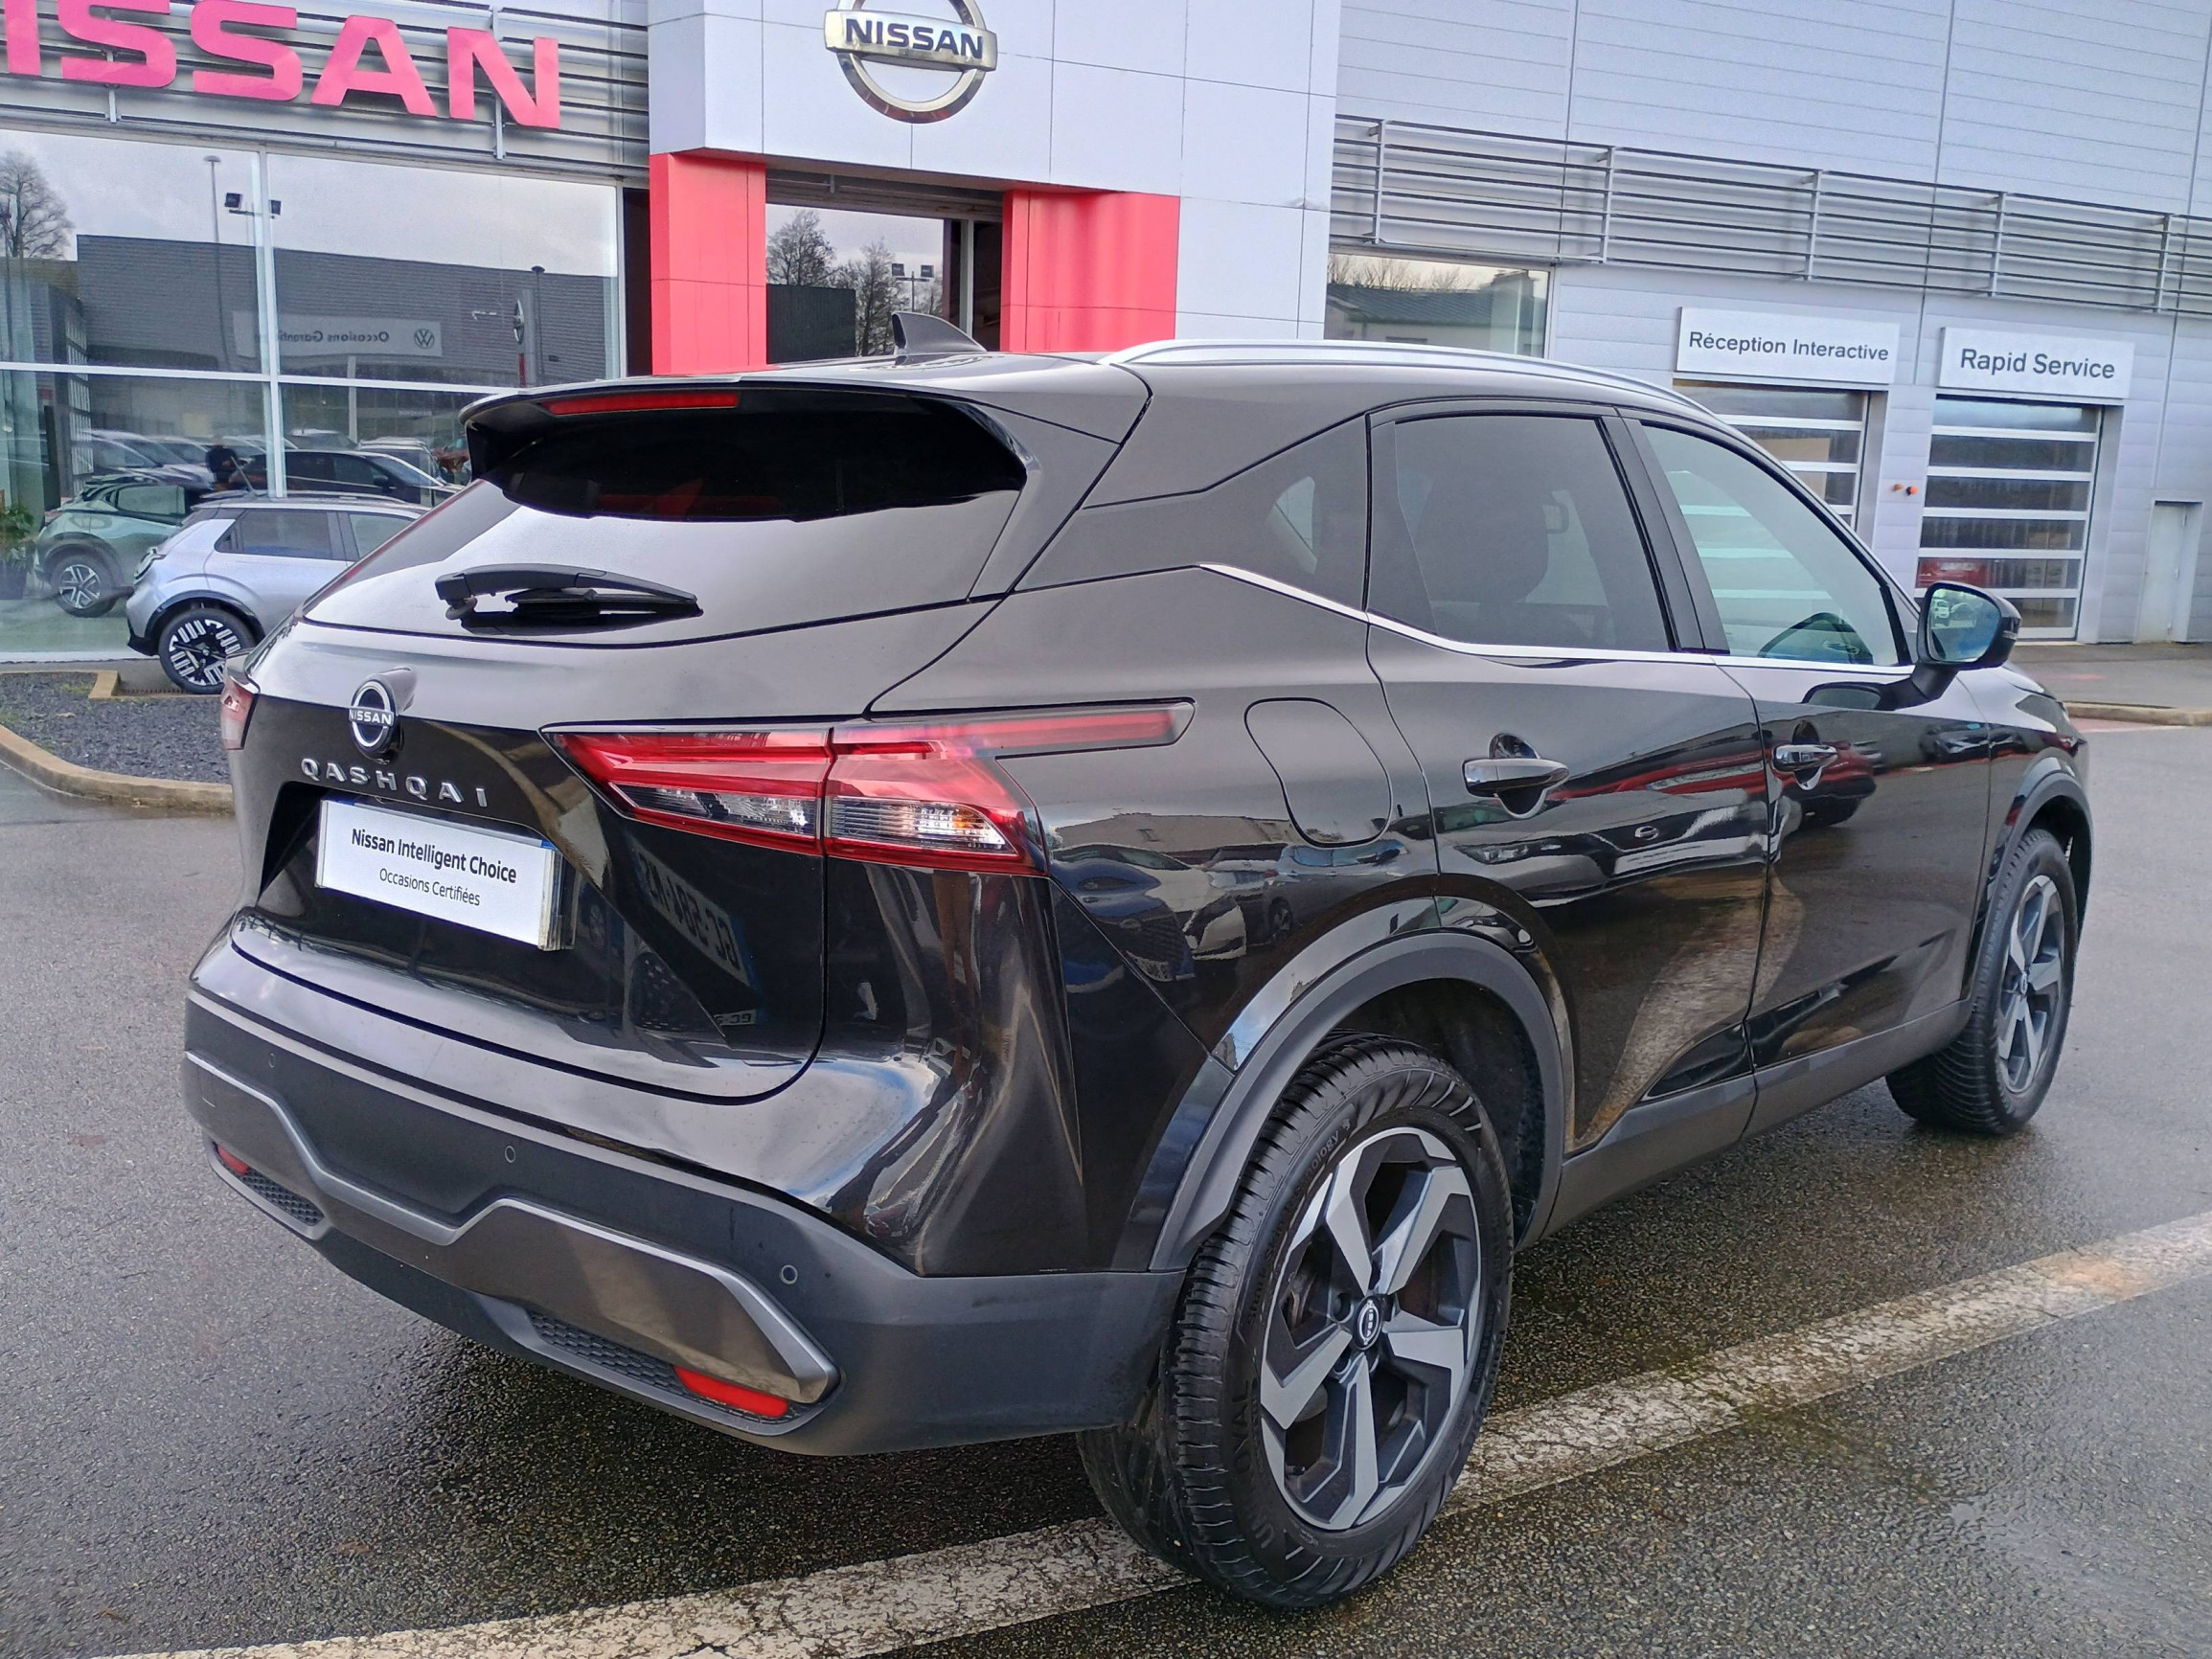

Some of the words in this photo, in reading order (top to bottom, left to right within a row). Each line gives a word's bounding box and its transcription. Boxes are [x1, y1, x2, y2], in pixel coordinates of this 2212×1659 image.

[846, 18, 984, 59] NISSAN
[1689, 331, 1786, 356] Réception
[1792, 338, 1890, 361] Interactive
[1960, 348, 2026, 375] Rapid
[2032, 352, 2115, 379] Service
[349, 709, 393, 726] NISSAN
[300, 758, 489, 807] QASHQAI
[352, 828, 395, 854] Nissan
[398, 838, 467, 871] Intelligent
[469, 855, 517, 883] Choice
[379, 868, 430, 893] Occasions
[432, 881, 481, 906] Certifiées
